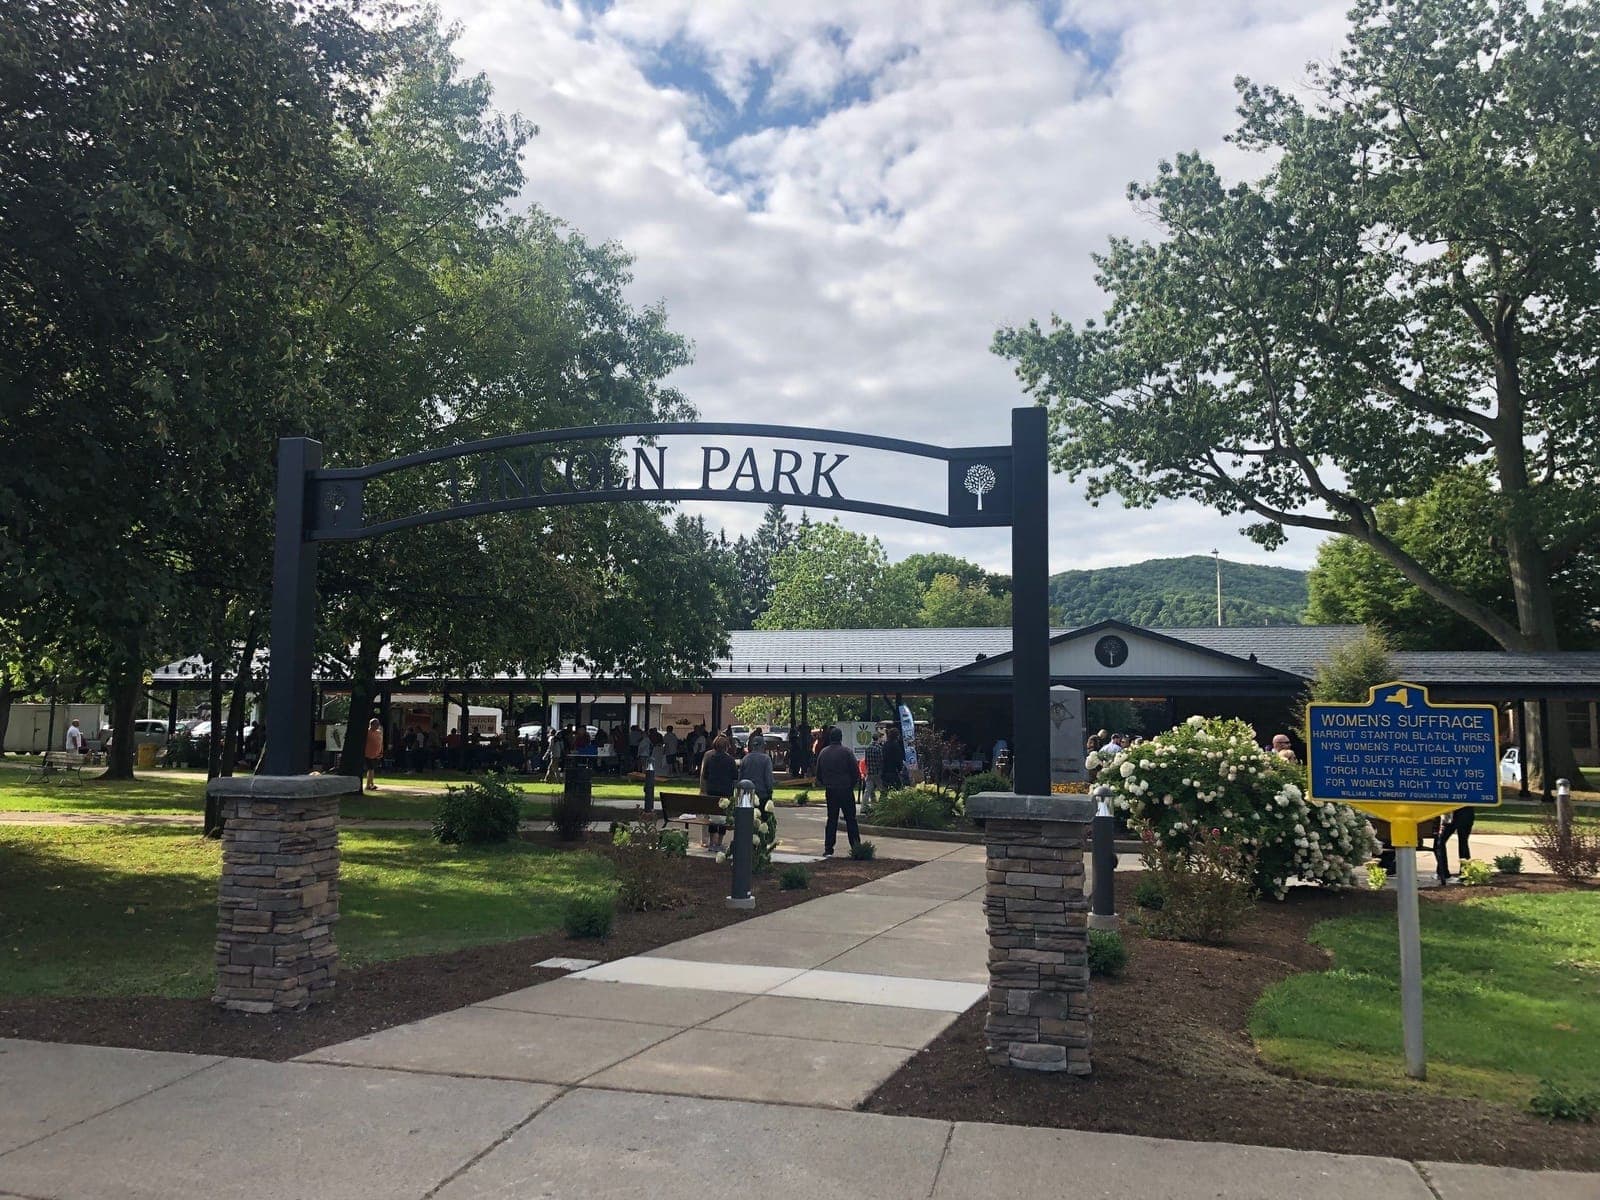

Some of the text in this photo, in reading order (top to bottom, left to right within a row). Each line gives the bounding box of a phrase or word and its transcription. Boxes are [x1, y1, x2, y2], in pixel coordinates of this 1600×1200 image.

[447, 446, 849, 508] LINCOLN PARK
[1321, 714, 1484, 729] WOMEN'S SUFFRAGE
[1312, 730, 1356, 739] HARRIOT
[1360, 730, 1408, 740] STANTON
[1321, 742, 1485, 753] NYS WOMEN'S POLITICAL UNION
[1333, 754, 1470, 765] HELD SUFFRAGE LIBERTY
[1324, 766, 1485, 778] TORCH RALLY HERE JULY 1915
[1325, 778, 1484, 791] FOR WOMEN'S RIGHT TO VOTE
